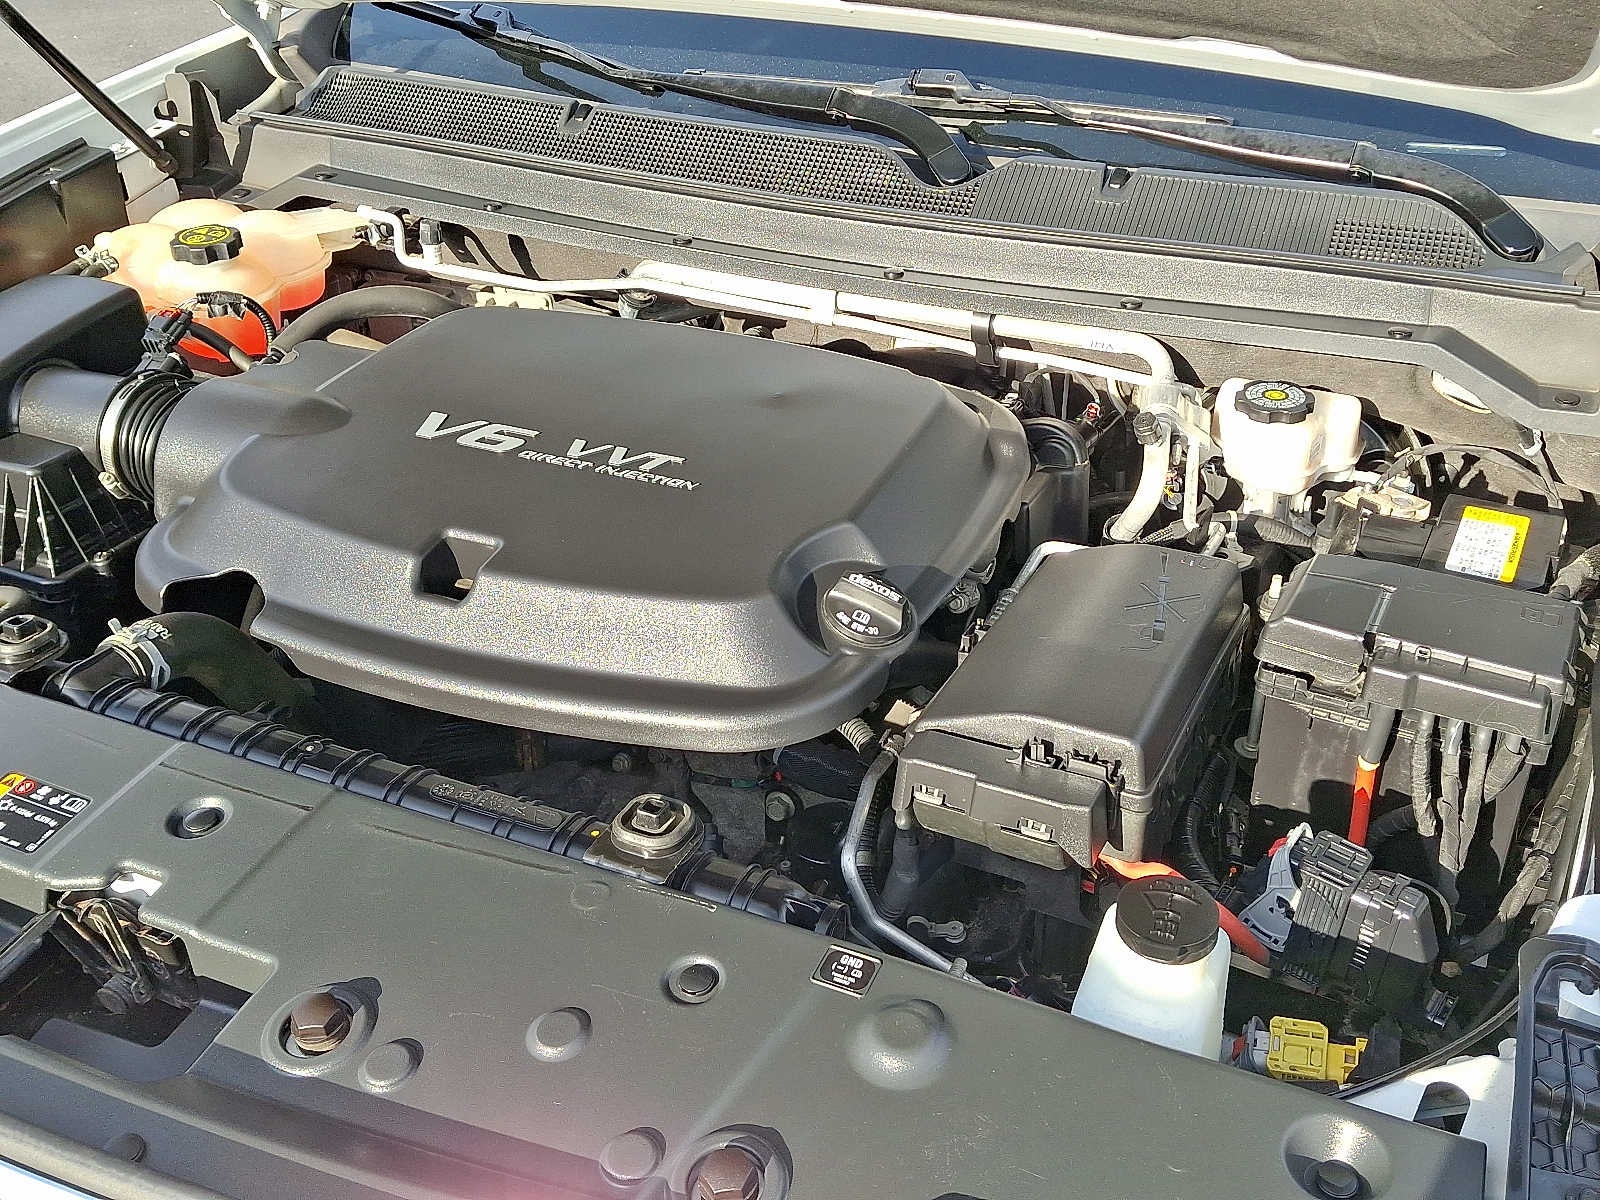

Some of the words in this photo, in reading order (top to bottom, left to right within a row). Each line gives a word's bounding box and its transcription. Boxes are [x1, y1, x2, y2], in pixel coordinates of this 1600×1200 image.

[415, 411, 541, 453] V6
[566, 438, 687, 472] VVT
[517, 450, 594, 470] DIRECT
[594, 464, 701, 491] INJECTION
[848, 573, 903, 602] dexos
[840, 954, 864, 969] GND
